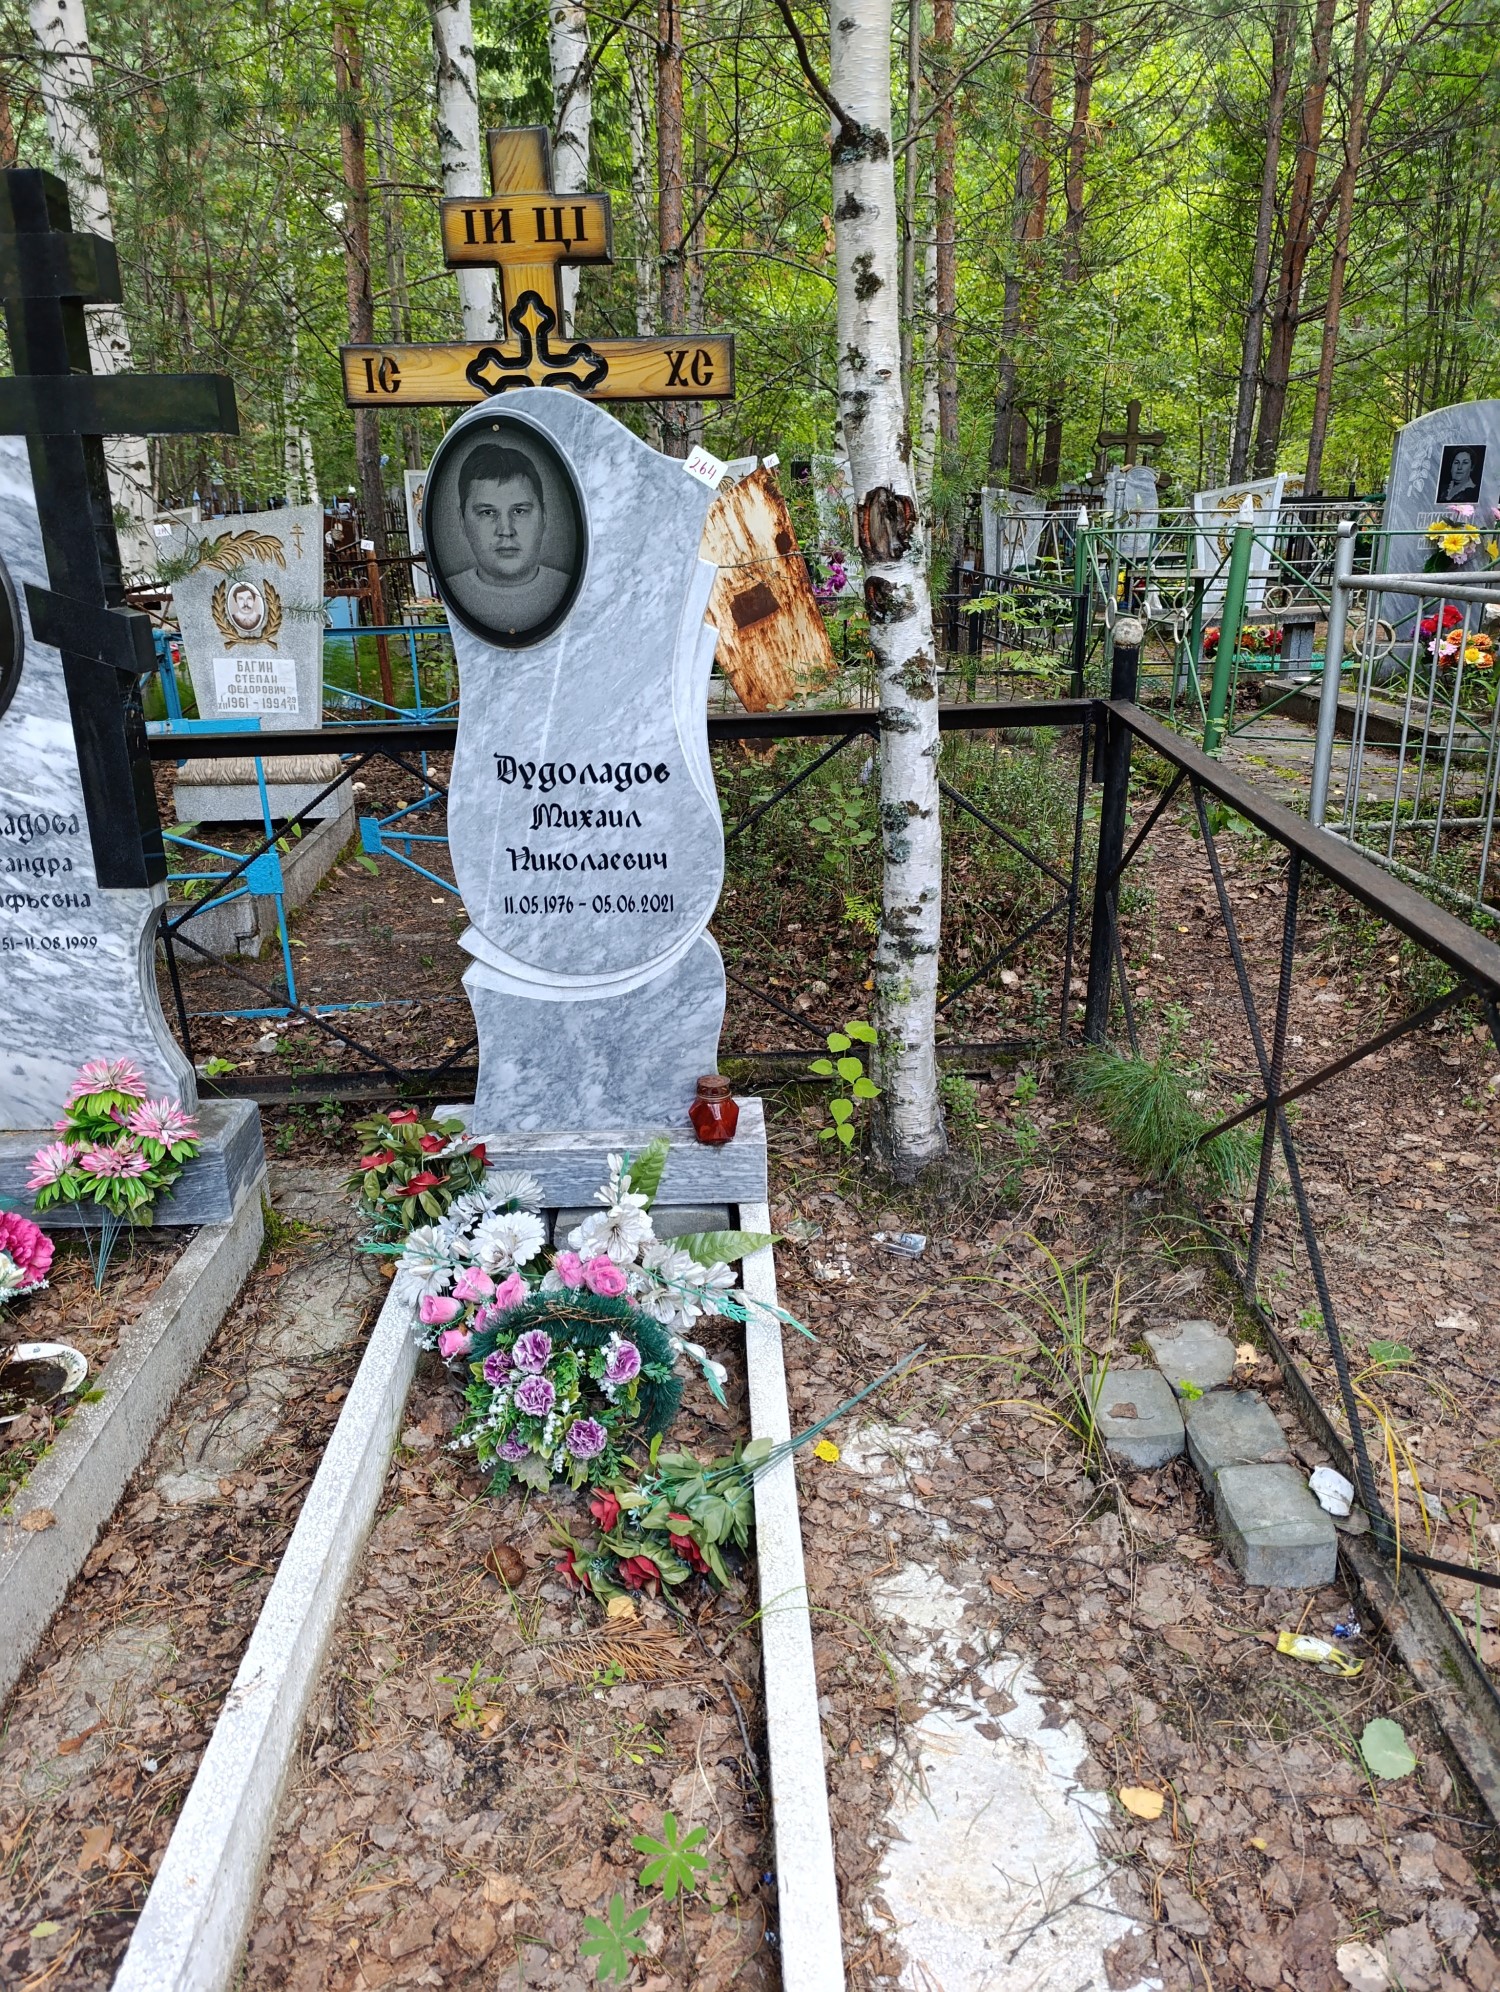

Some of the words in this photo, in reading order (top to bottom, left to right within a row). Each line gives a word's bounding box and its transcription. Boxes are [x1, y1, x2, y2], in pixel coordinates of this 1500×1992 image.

[688, 456, 717, 480] 264
[236, 660, 273, 673] БАГИН
[227, 684, 286, 695] ФЕДОРОВИЧ
[235, 674, 278, 684] СТЕПАН
[227, 697, 249, 709] 1961
[262, 697, 287, 709] 1994
[493, 752, 671, 793] Дудоладов
[529, 803, 642, 831] Михаил
[0, 813, 80, 845] адова
[0, 857, 73, 878] андра
[505, 846, 668, 872] Николаевич
[504, 895, 574, 915] 11.05.1976
[592, 894, 674, 914] 05.06.2021
